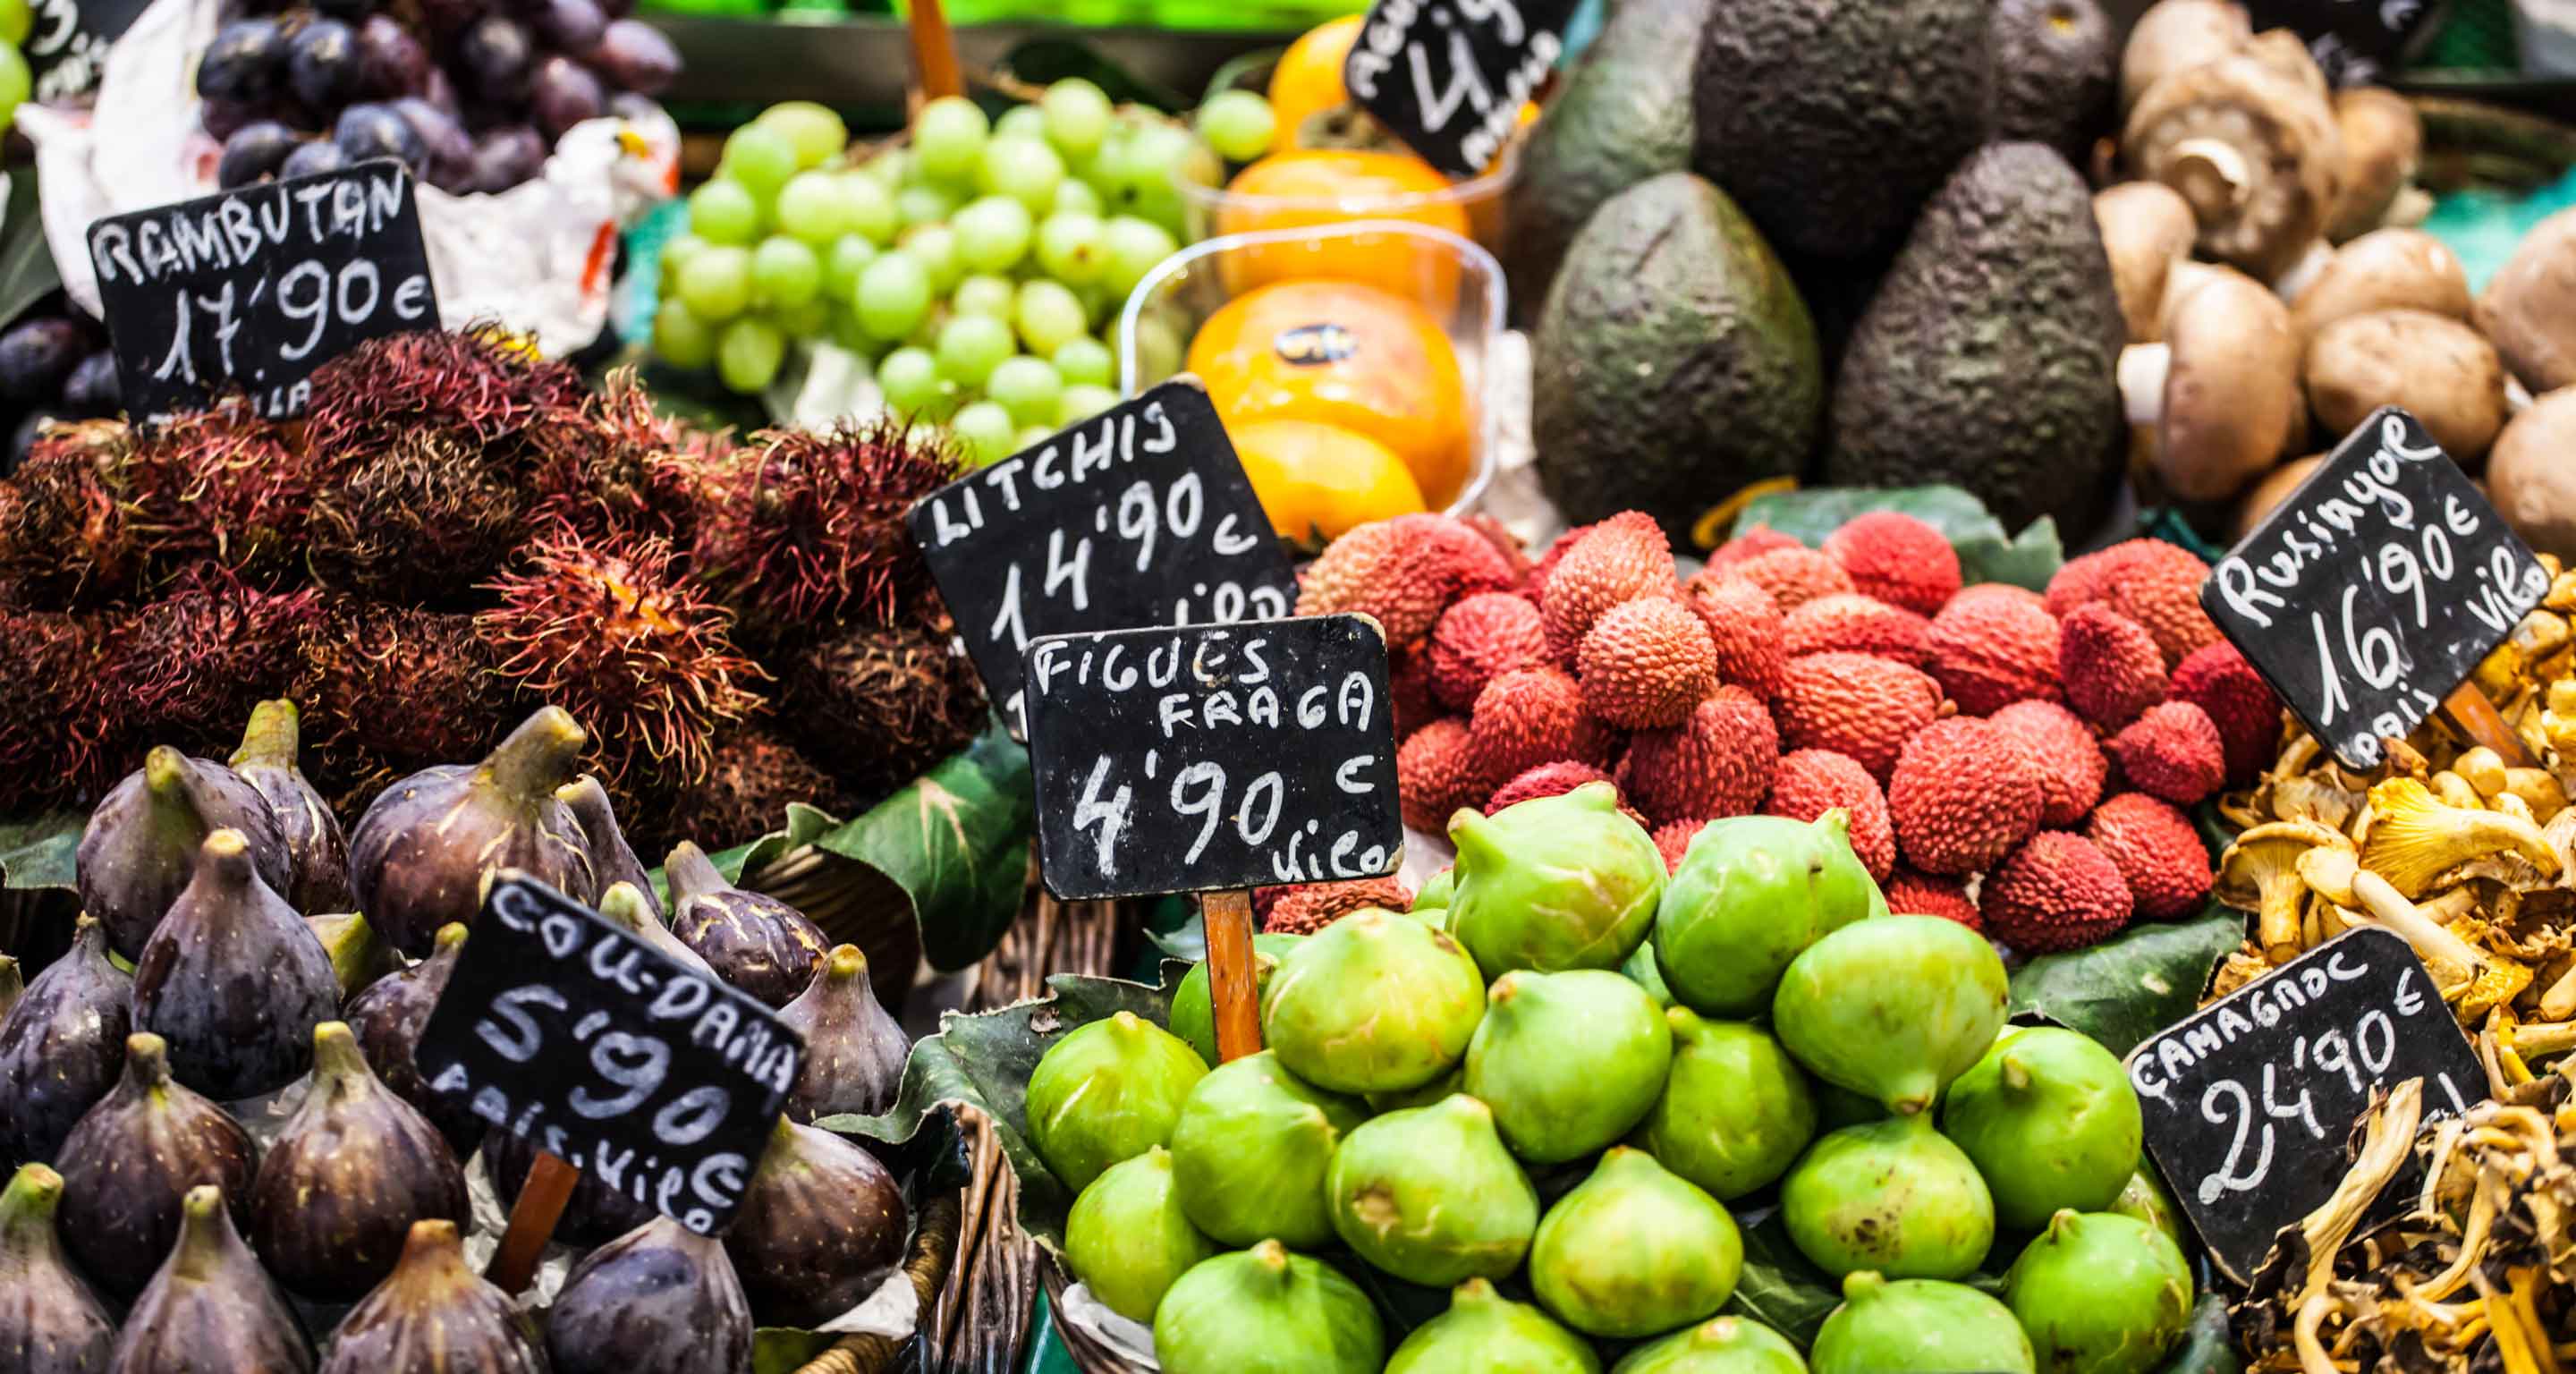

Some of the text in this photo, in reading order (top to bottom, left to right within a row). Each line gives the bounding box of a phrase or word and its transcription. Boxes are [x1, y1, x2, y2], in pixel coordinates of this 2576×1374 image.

[91, 165, 405, 286] RAMBUTAN
[153, 259, 381, 386] 17'90
[932, 401, 1176, 547] LITCHIS
[989, 471, 1204, 653] 14'90
[2312, 522, 2454, 726] 16'90
[1158, 671, 1374, 738] FRAGA
[1072, 748, 1284, 880] 4'90
[475, 985, 731, 1147] 5'90
[2198, 1008, 2396, 1207] 24'90
